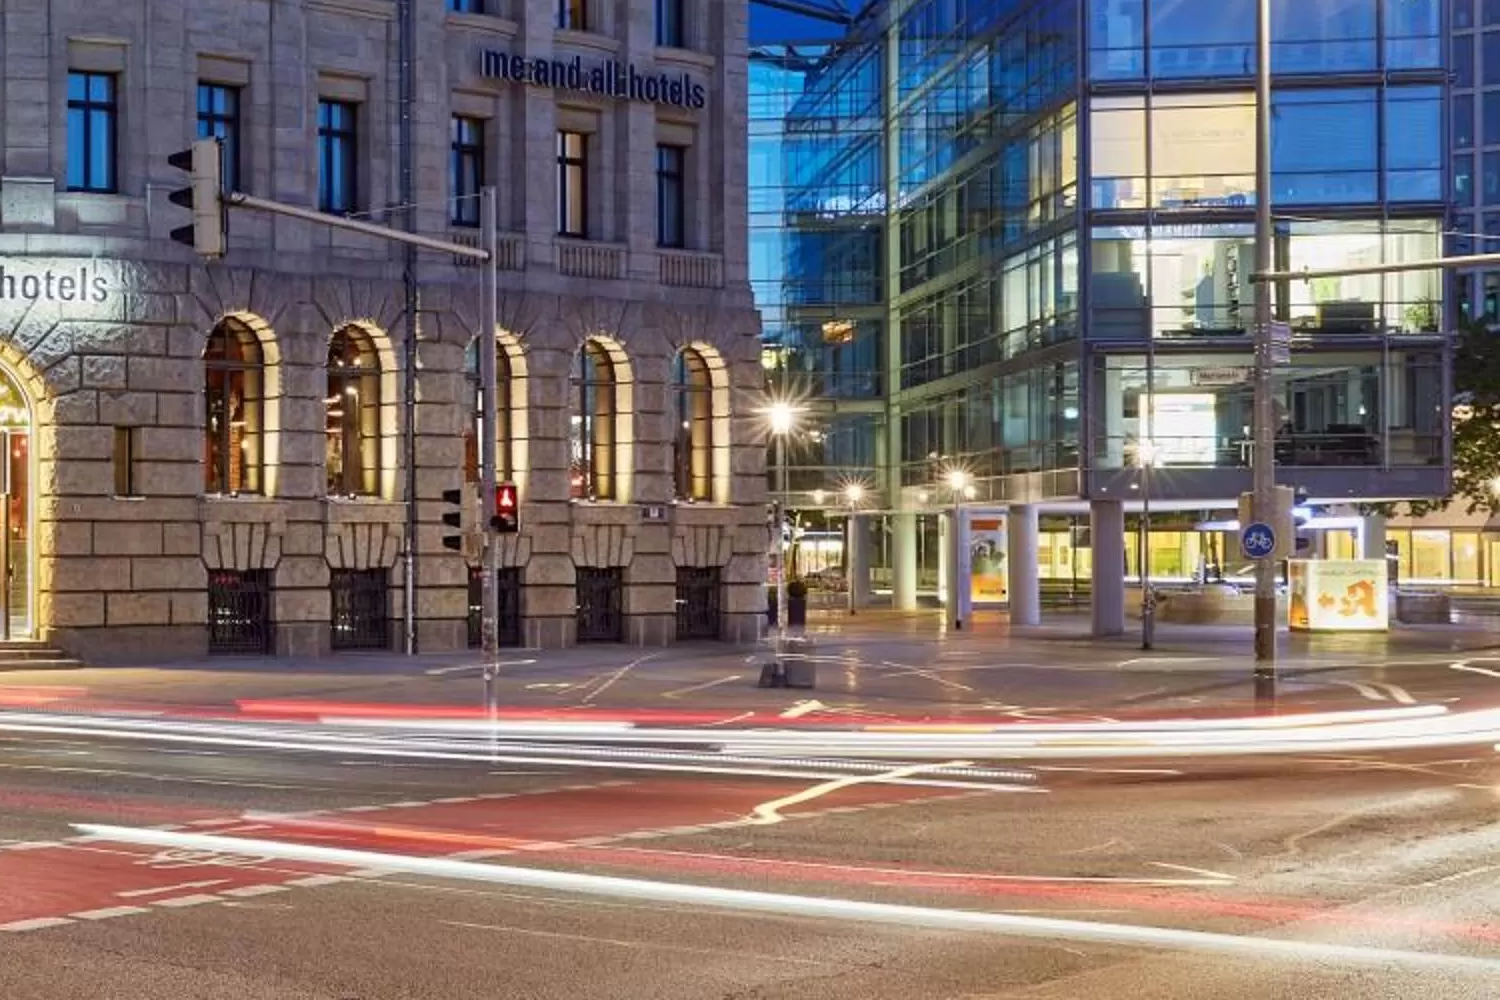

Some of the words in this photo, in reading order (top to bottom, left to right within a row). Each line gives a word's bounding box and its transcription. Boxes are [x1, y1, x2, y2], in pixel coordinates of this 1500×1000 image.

[481, 49, 524, 81] me
[531, 56, 581, 90] and
[589, 59, 620, 96] all
[629, 64, 705, 109] hotels
